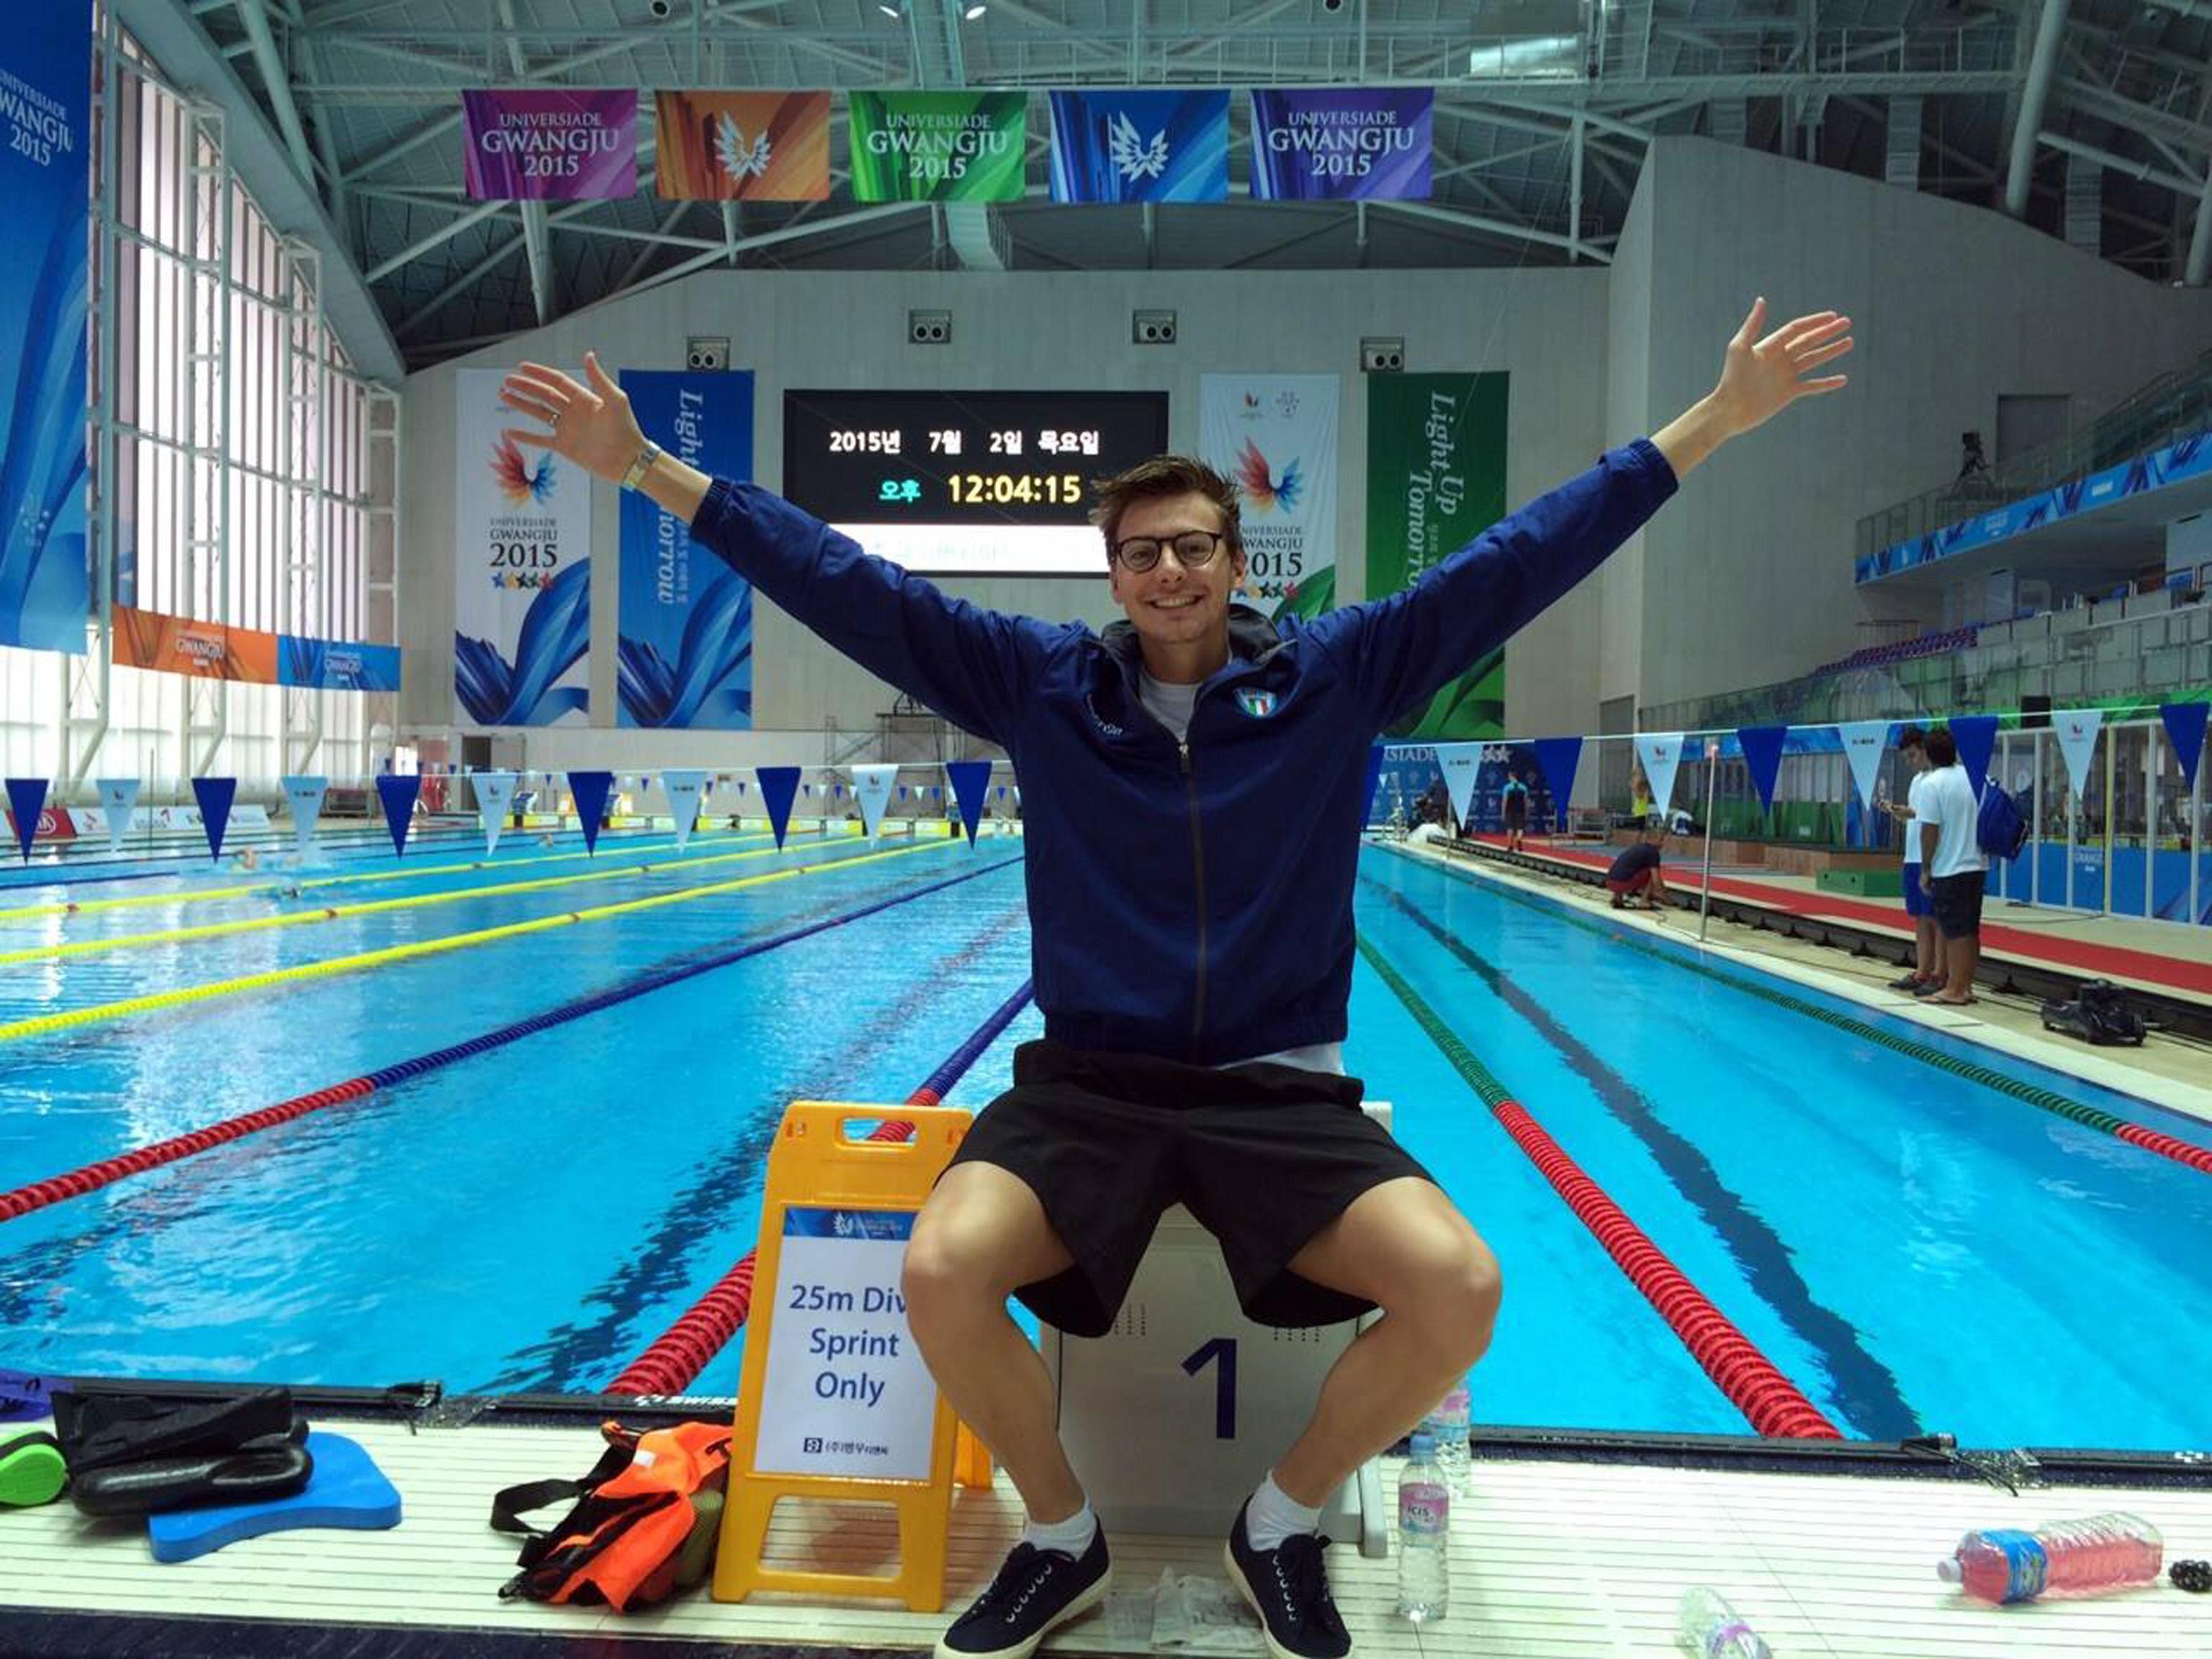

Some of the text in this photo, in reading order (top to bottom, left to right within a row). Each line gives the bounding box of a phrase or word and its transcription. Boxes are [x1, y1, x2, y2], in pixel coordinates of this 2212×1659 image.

[0, 86, 73, 153] WANGJU
[500, 112, 602, 127] UNIVERSIADE
[886, 114, 991, 128] UNIVERSIADE
[1288, 110, 1397, 125] UNIVERSIADE
[10, 124, 50, 166] 2015
[481, 129, 619, 157] GWANGJU
[867, 130, 1008, 159] GWANGJU
[1268, 127, 1415, 156] GWANGJU
[524, 154, 580, 176] 2015
[909, 157, 967, 179] 2015
[1311, 153, 1371, 176] 2015
[830, 430, 1100, 455] 2015년 7월 2일 목요일
[1425, 391, 1465, 515] Light Up
[878, 475, 1081, 503] 오후 12:04:15
[490, 518, 556, 526] UNIVERSIADE
[1244, 526, 1300, 535] NIVERSIADE
[1408, 469, 1433, 587] Tomorro
[490, 529, 557, 542] GWANGJU
[1244, 538, 1303, 550] WANGJU
[490, 543, 557, 567] 2015
[1245, 552, 1302, 577] 015
[790, 1285, 906, 1313] 25m Div
[809, 1328, 899, 1361] Sprint
[815, 1371, 885, 1408] Only
[1180, 1337, 1237, 1439] 1
